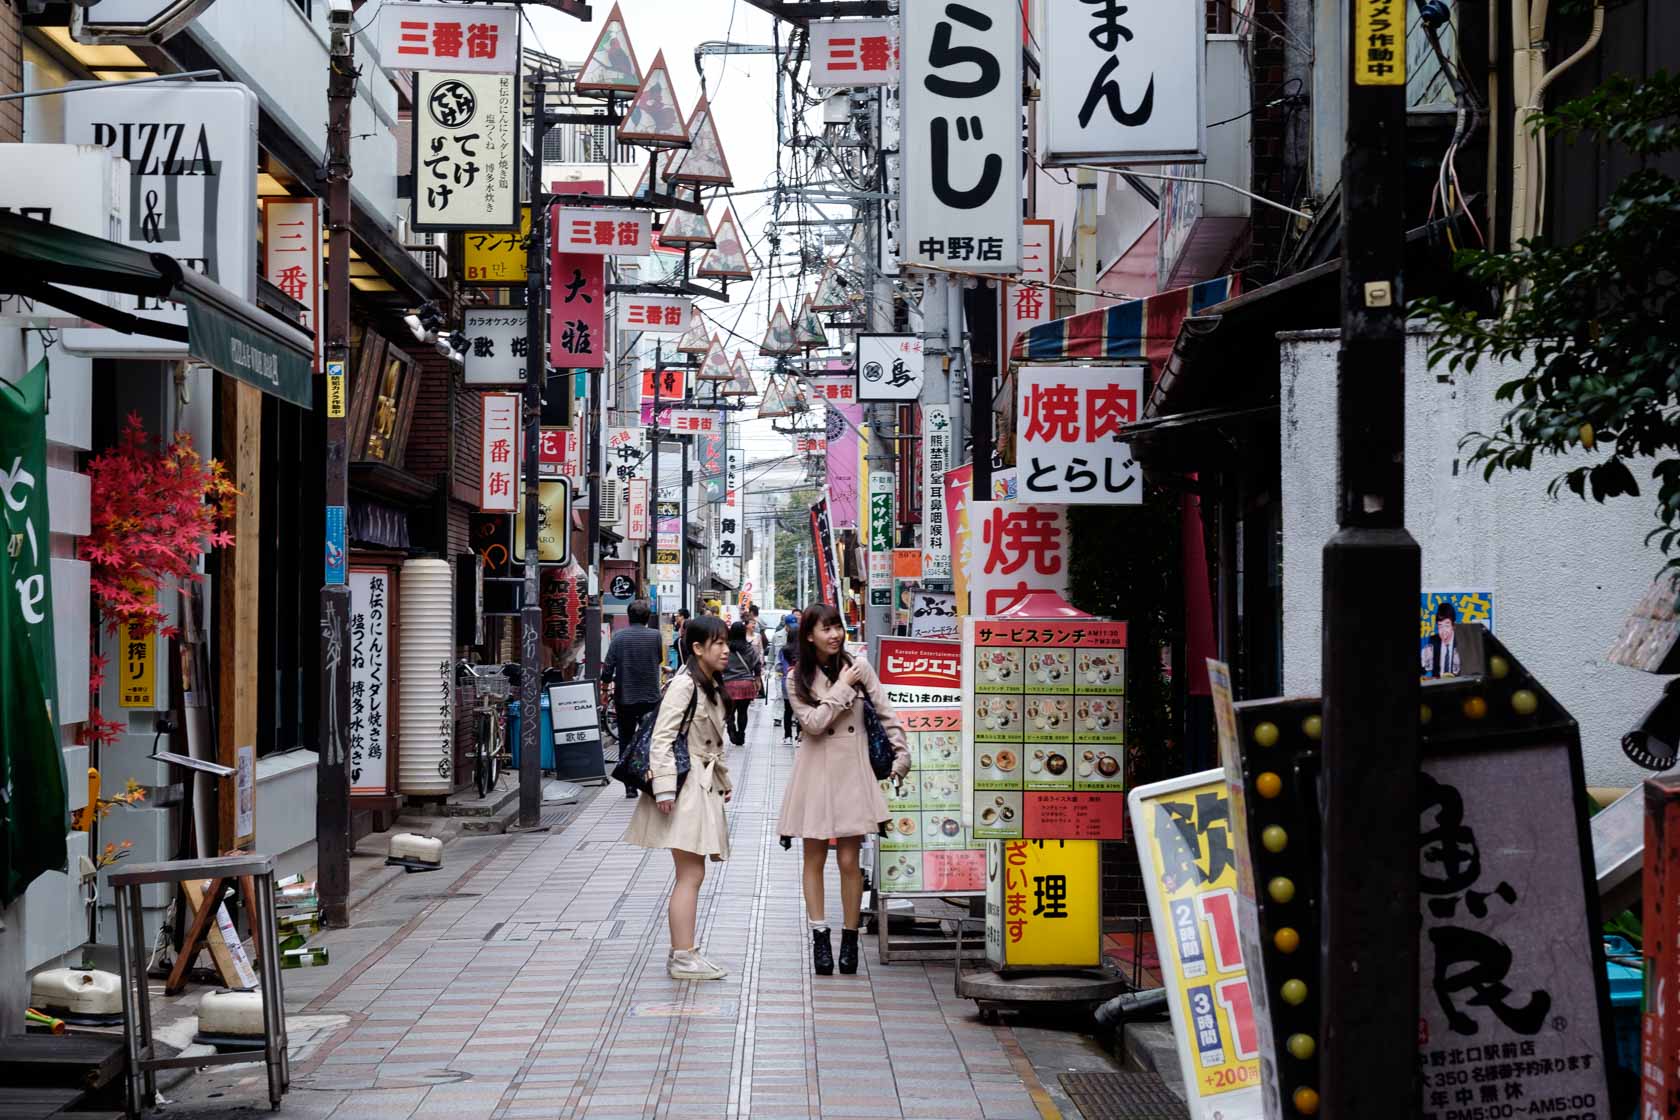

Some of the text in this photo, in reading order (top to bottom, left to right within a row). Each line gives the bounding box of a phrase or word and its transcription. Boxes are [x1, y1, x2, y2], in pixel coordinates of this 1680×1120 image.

[398, 22, 498, 59] 三番街
[827, 36, 899, 71] 三番
[1078, 0, 1154, 129] まん
[924, 4, 1003, 210] らじ
[91, 123, 217, 177] PIZZA
[143, 190, 163, 244] &
[570, 220, 639, 247] 三番街
[918, 237, 1004, 262] 中野店
[274, 219, 309, 327] 三番
[468, 266, 488, 279] B1
[627, 305, 682, 326] 三番街
[812, 385, 854, 399] 三番街
[1023, 383, 1138, 443] 焼肉
[676, 417, 712, 430] 三番街
[489, 408, 511, 496] 三番街
[1026, 457, 1135, 493] とらじ
[351, 613, 365, 669] 塩つくね
[978, 628, 1087, 644] サービスランチ
[1032, 839, 1068, 919] 理
[1174, 904, 1200, 958] 2時間
[1193, 992, 1219, 1047] 3時間
[1430, 1083, 1524, 1108] 年中無休
